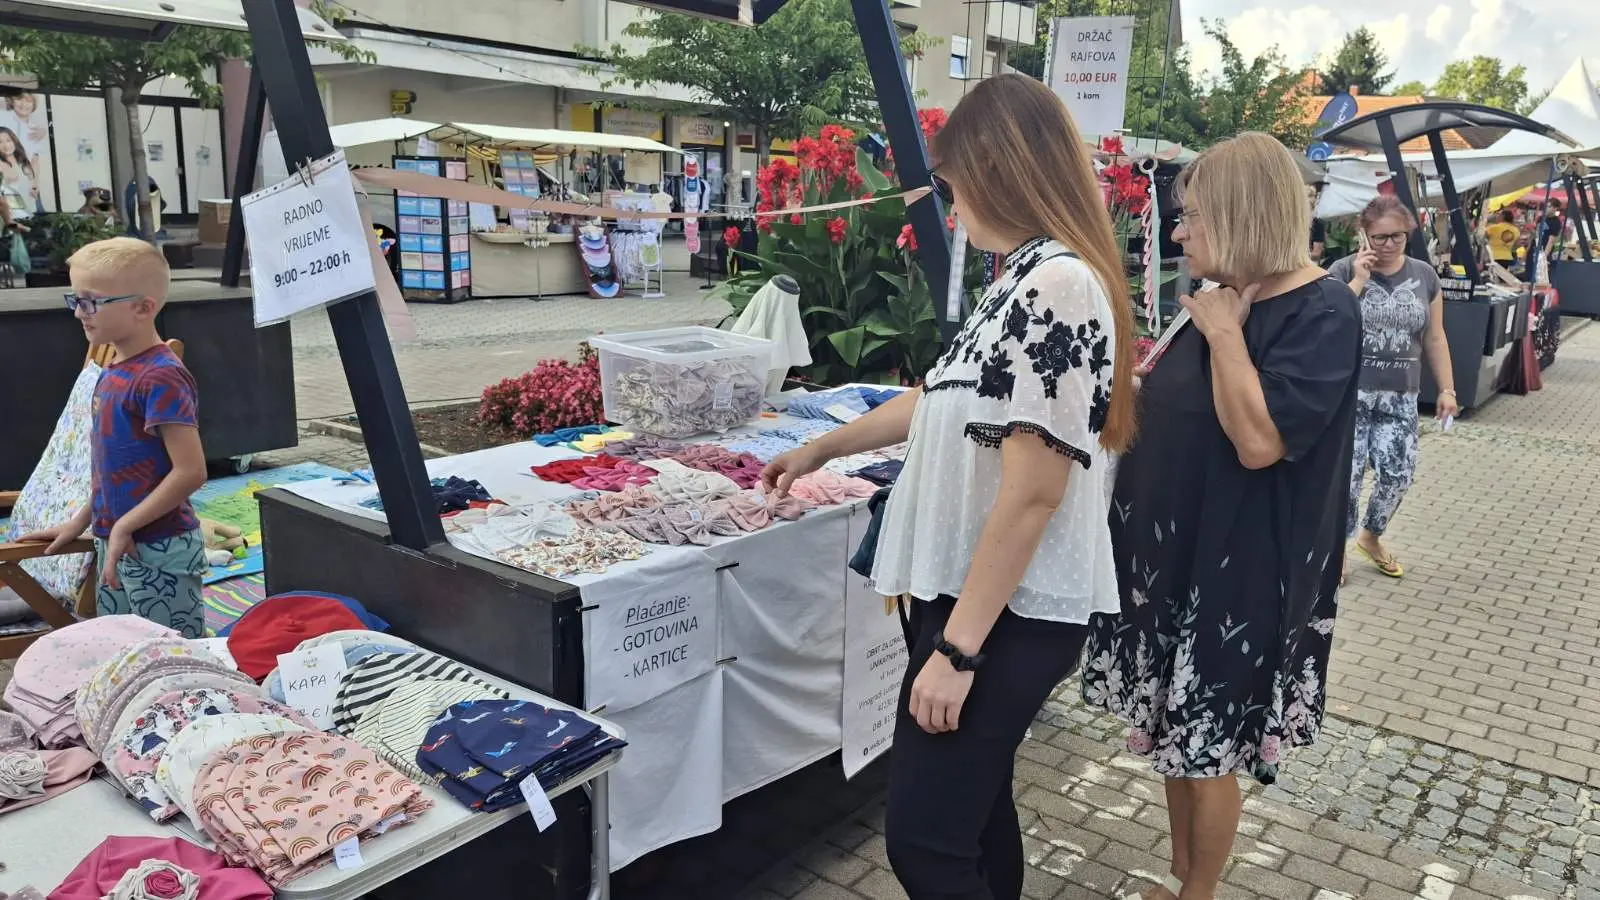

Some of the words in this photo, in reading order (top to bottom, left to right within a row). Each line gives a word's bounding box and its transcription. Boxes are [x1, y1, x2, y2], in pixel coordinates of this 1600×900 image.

[1077, 28, 1113, 42] DRŽAČ
[1070, 51, 1116, 62] RAJFOVA
[1064, 73, 1092, 84] 10,00
[1095, 73, 1117, 82] EUR
[1077, 92, 1081, 100] 1
[1083, 91, 1100, 100] kom
[284, 198, 323, 226] RADNO
[284, 225, 331, 253] VRIJEME
[274, 268, 298, 288] 9:00
[309, 253, 341, 276] 22:00
[342, 250, 351, 265] h
[625, 595, 691, 626] Plaćanje:
[623, 616, 698, 652] GOTOVINA
[632, 644, 688, 678] KARTICE
[289, 674, 327, 691] KAPA
